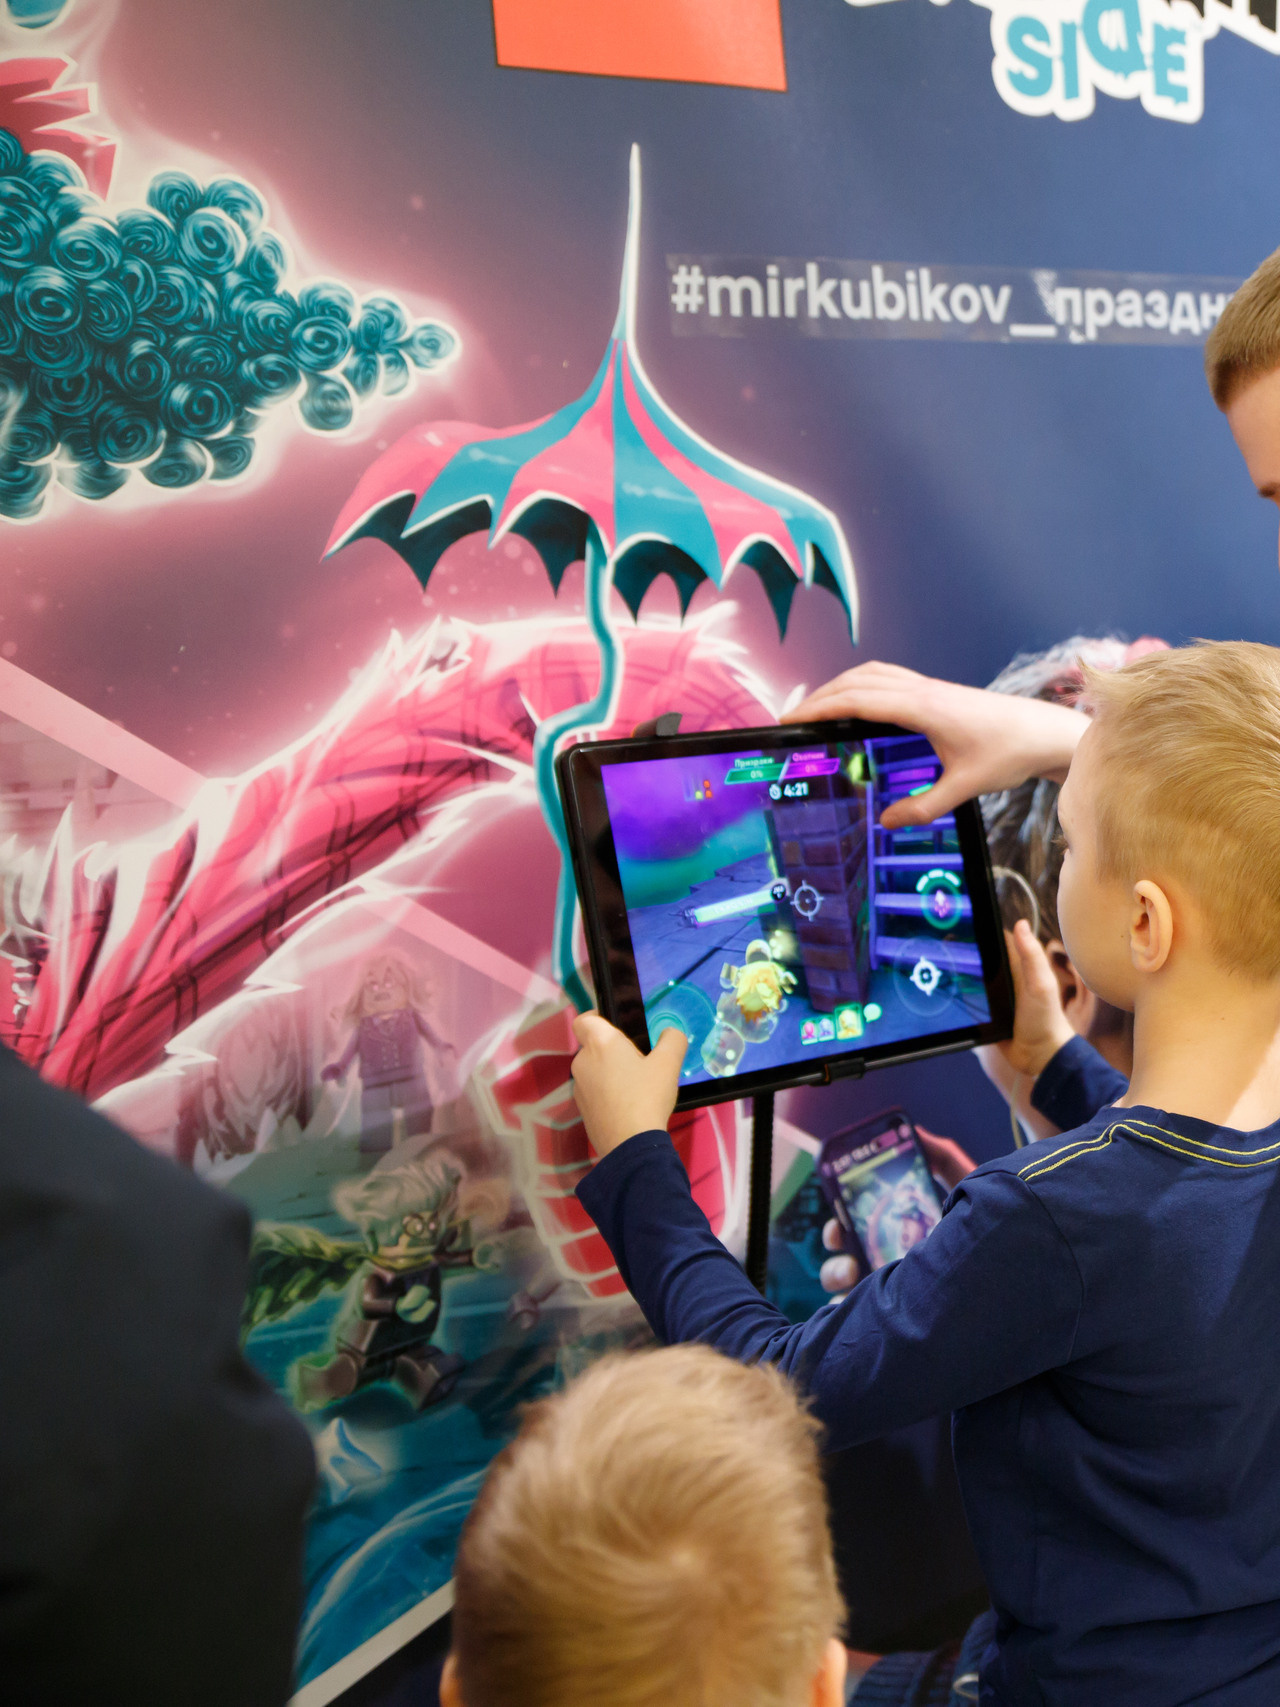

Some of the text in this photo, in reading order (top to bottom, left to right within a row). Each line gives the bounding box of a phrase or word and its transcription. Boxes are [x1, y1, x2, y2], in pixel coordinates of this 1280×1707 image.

[1006, 0, 1189, 105] SIDE
[671, 262, 1234, 341] #mirkubikov_праздн
[783, 781, 809, 797] 4:21
